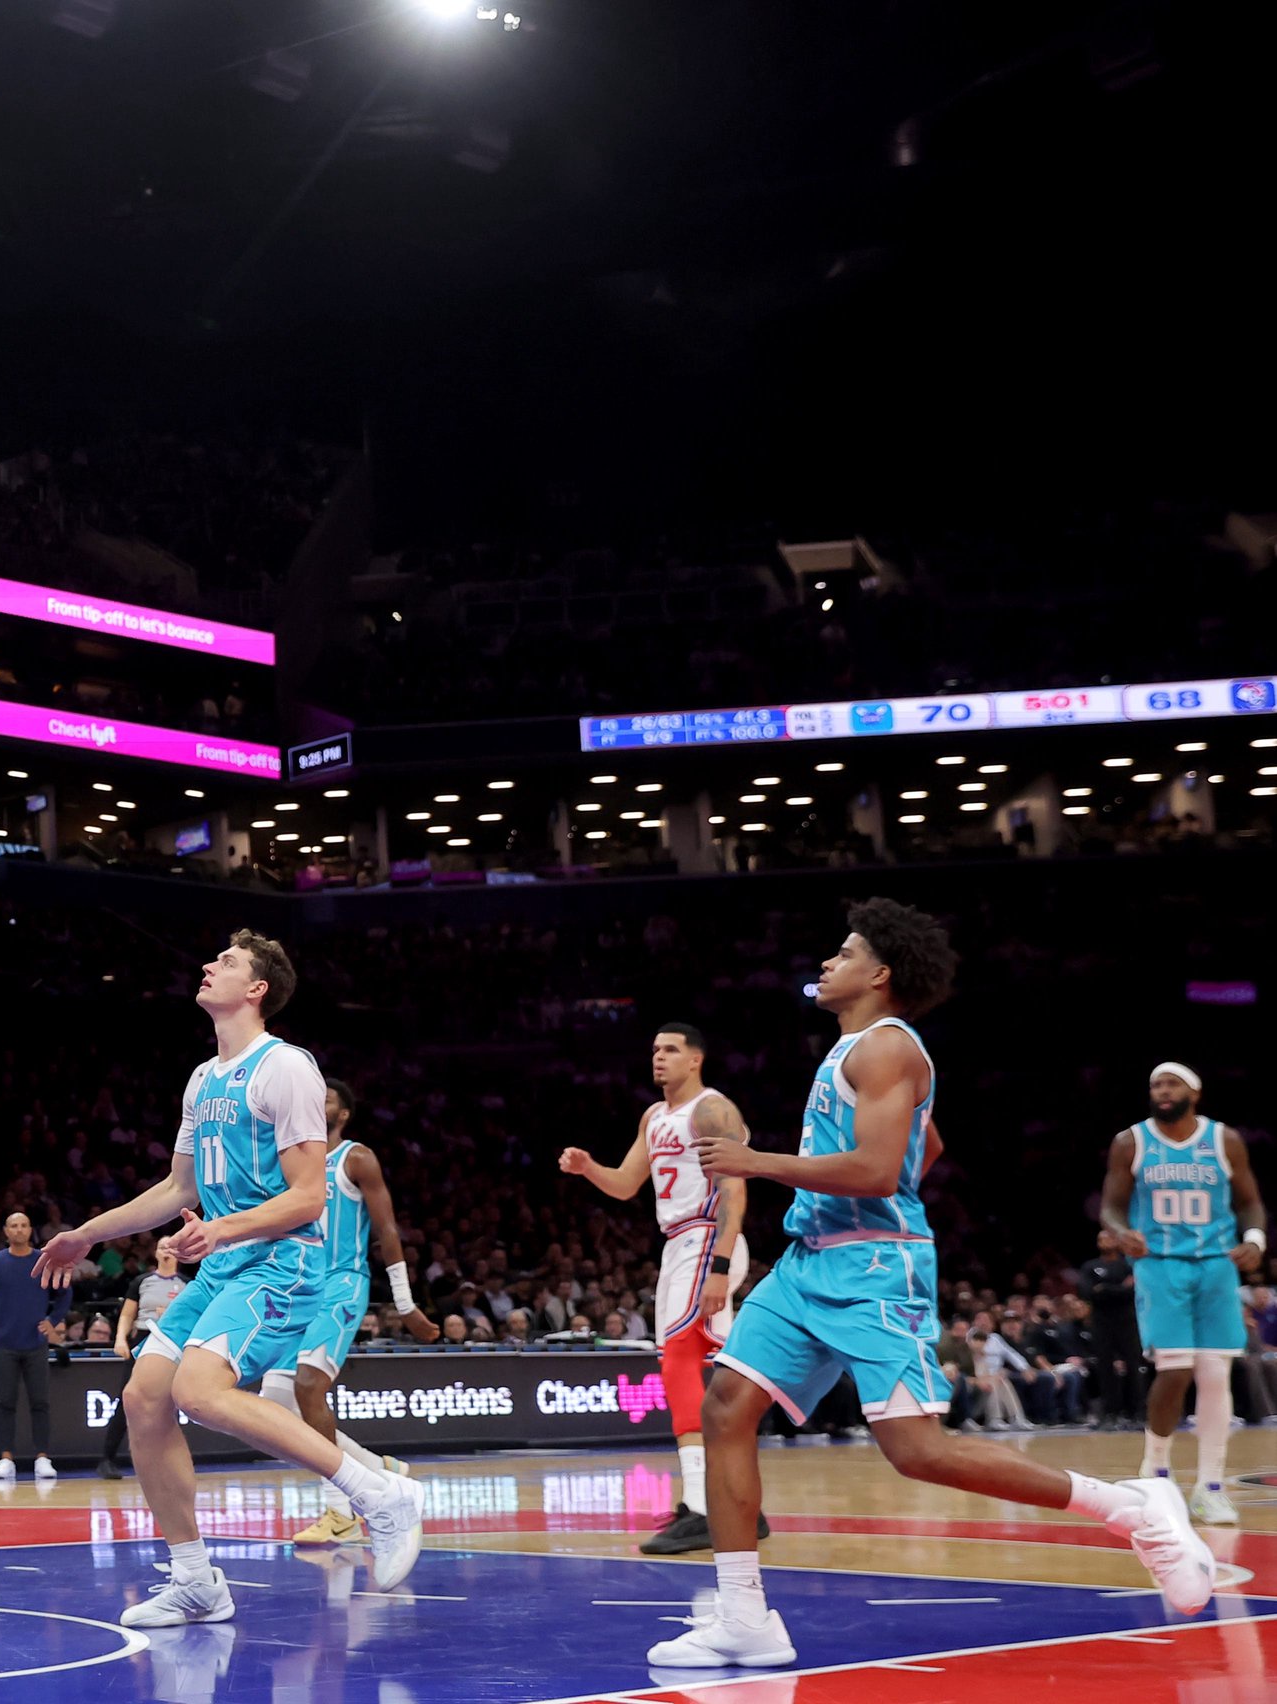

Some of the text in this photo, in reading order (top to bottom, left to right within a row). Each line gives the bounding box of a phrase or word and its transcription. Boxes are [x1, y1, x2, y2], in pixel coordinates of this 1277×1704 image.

[47, 597, 215, 645] From tip-off to let's bounce
[916, 703, 972, 724] 70
[1148, 689, 1202, 711] 68
[48, 718, 117, 746] Check lyft
[195, 742, 282, 772] From tip-off to
[323, 745, 342, 763] PM
[201, 1136, 226, 1186] 11
[1144, 1163, 1219, 1186] HORNETS
[658, 1166, 678, 1200] 7
[1152, 1188, 1211, 1225] 00
[336, 1384, 407, 1420] have
[408, 1381, 514, 1424] options
[536, 1373, 668, 1424] Check lyft
